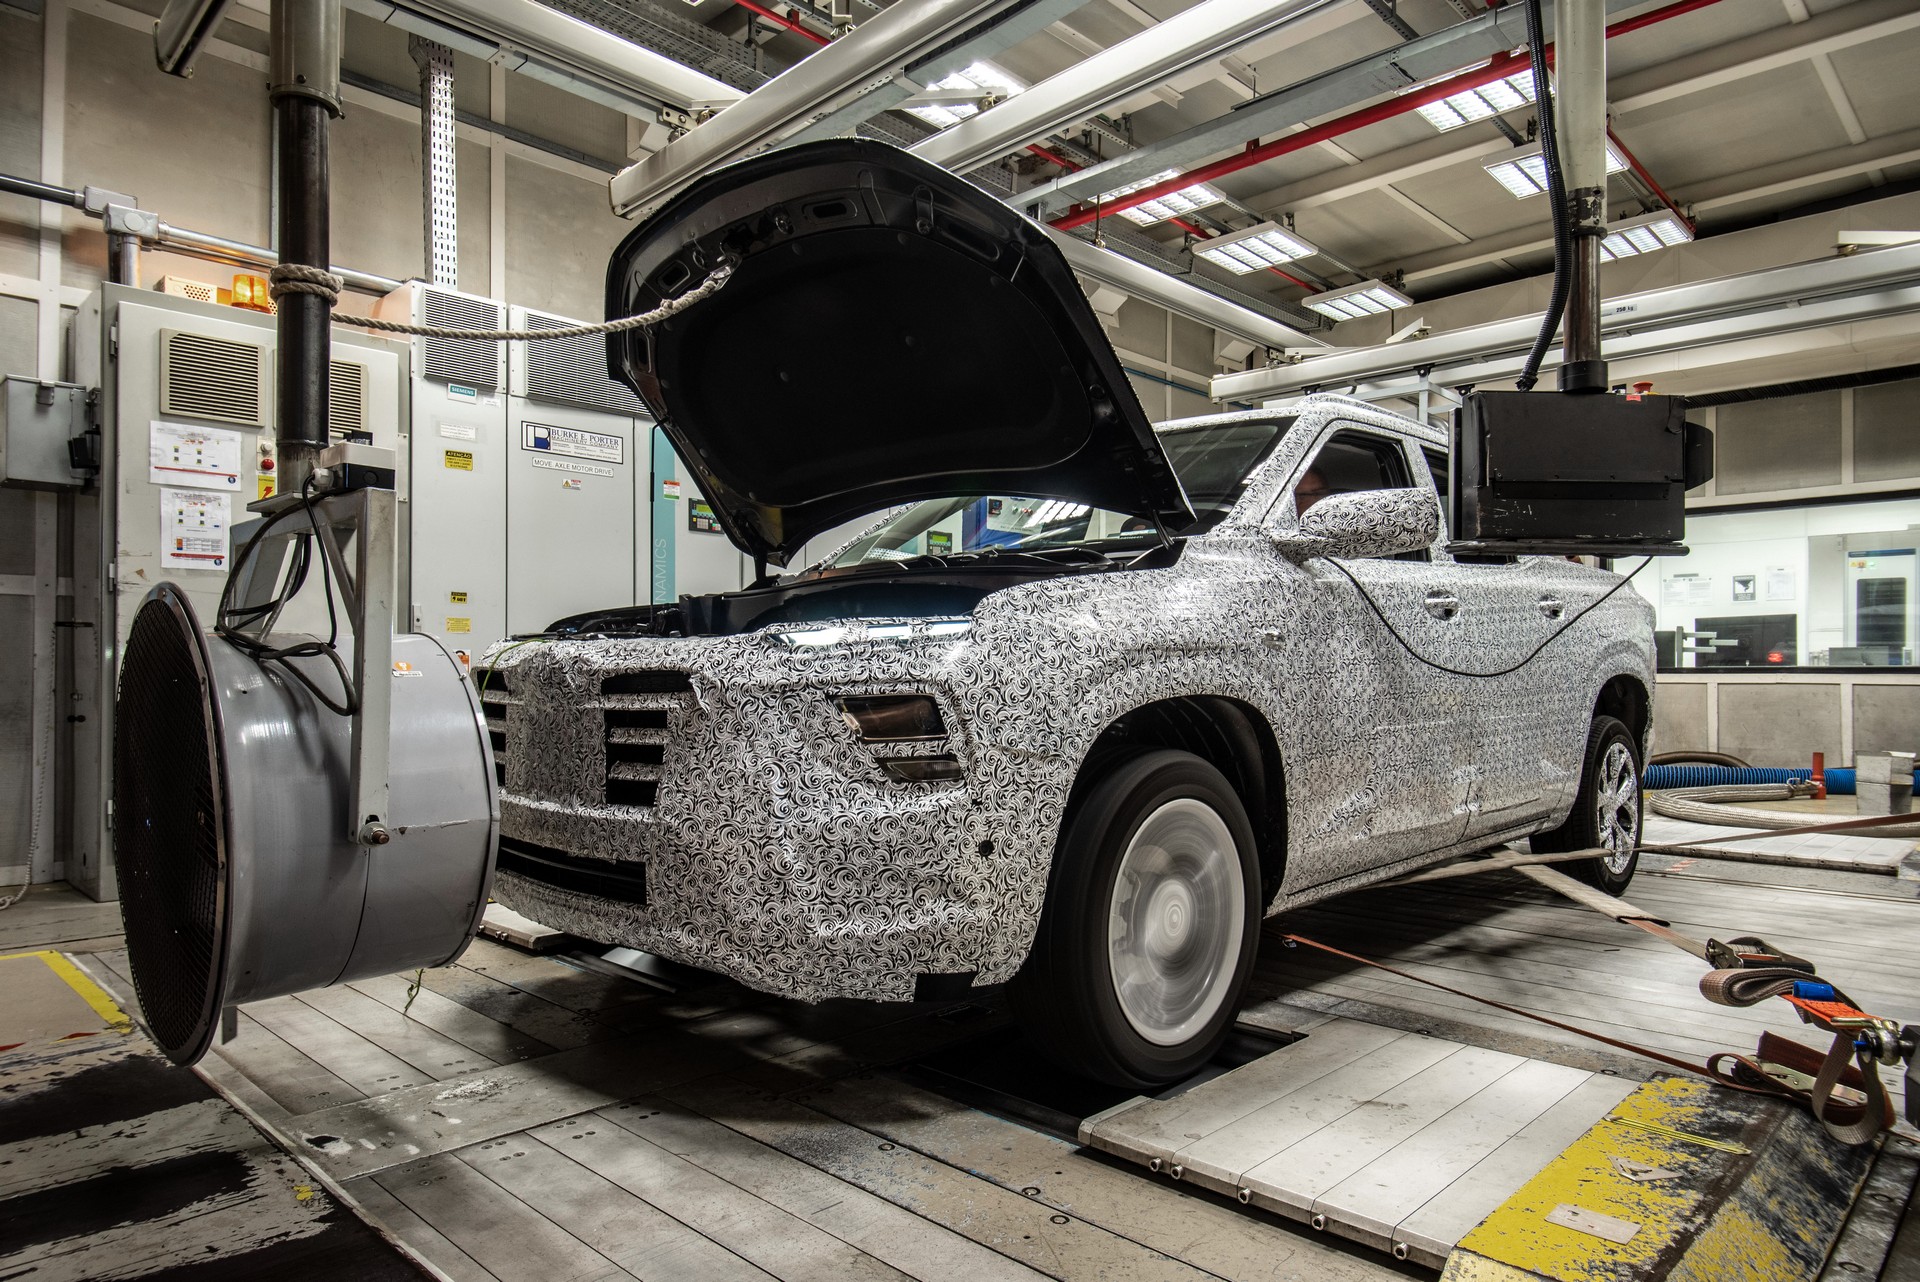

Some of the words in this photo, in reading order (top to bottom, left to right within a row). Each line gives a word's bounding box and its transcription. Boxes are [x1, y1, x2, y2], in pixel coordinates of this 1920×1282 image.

[452, 387, 474, 396] SIEMENS
[552, 428, 578, 439] BURKE
[590, 434, 619, 446] PORTER
[552, 435, 587, 445] MACHINERY
[590, 441, 619, 449] COMPANY
[572, 464, 593, 473] MOTOR
[594, 467, 612, 475] DRIVE
[655, 538, 667, 601] NAMICS
